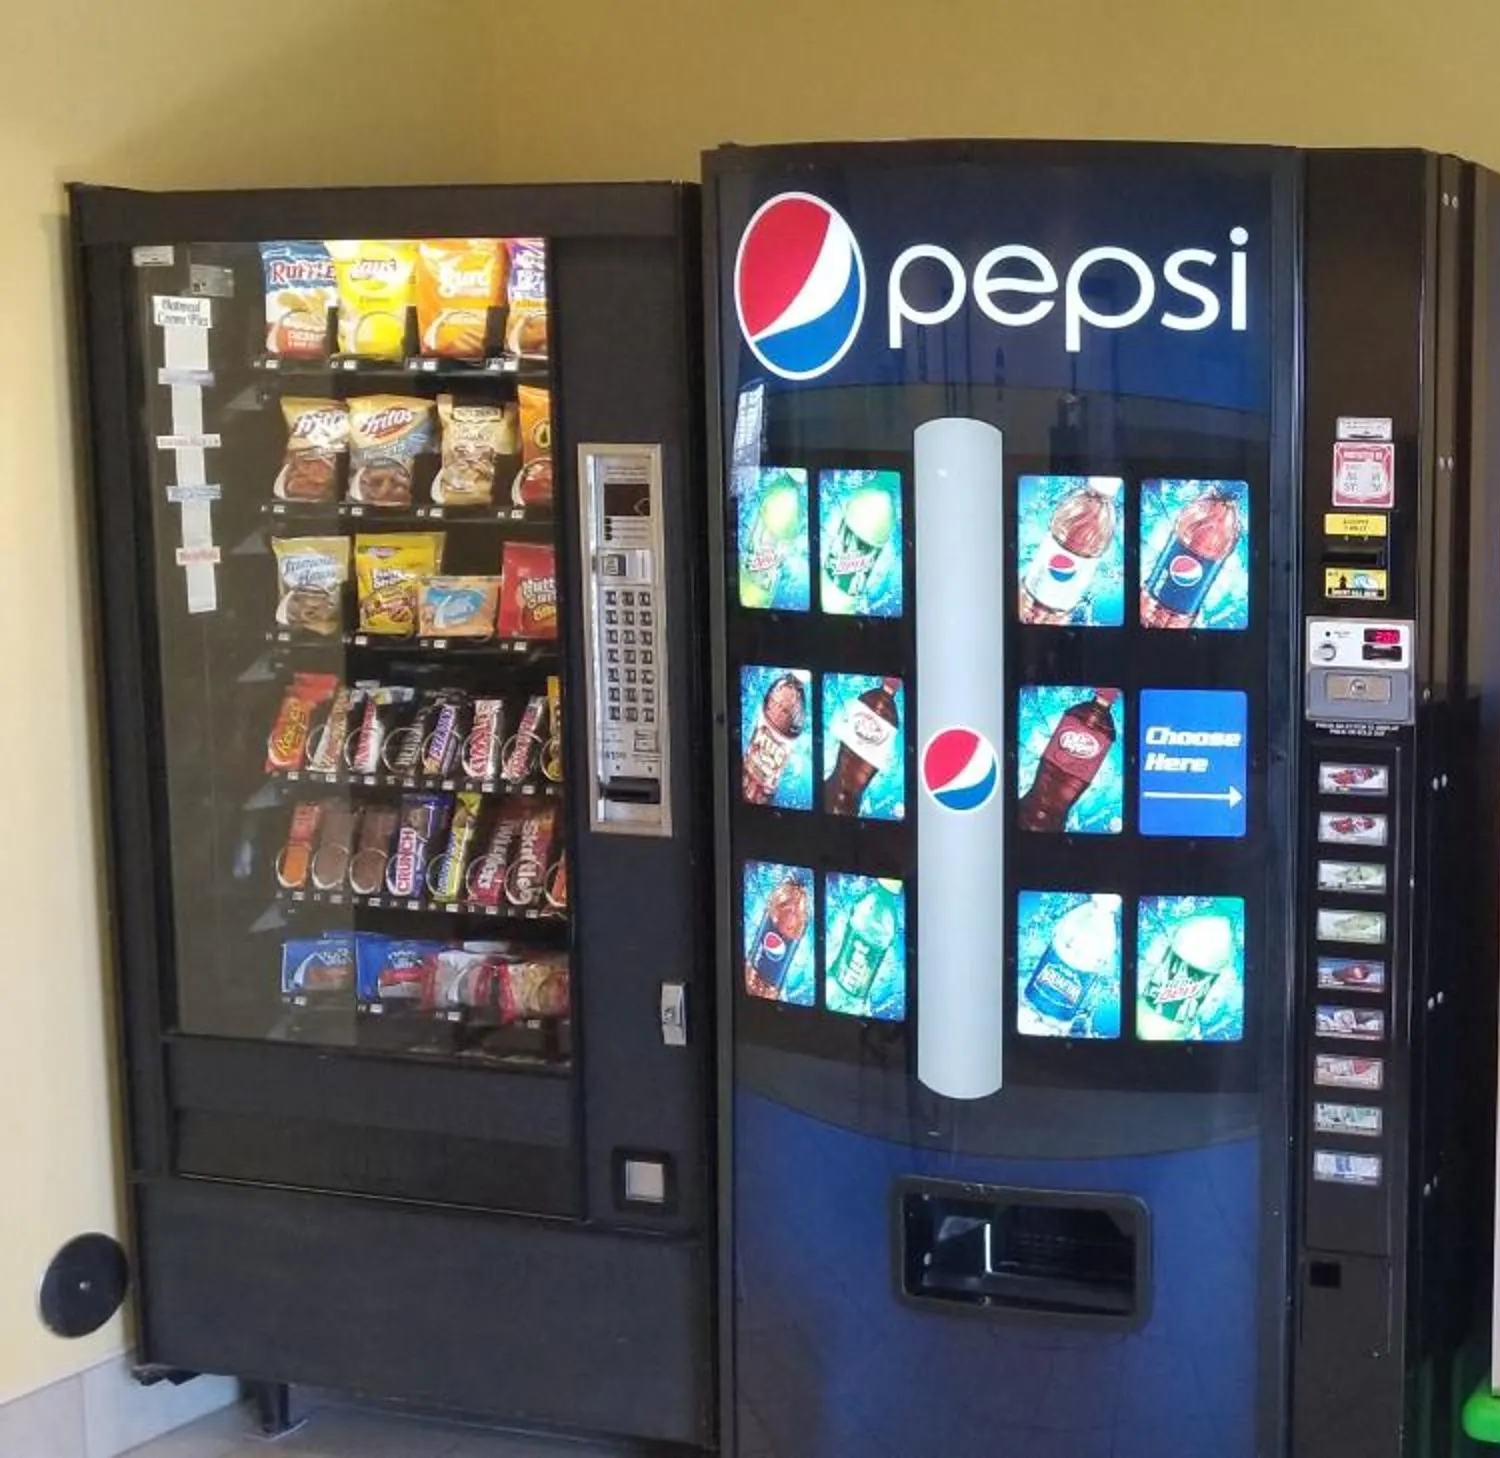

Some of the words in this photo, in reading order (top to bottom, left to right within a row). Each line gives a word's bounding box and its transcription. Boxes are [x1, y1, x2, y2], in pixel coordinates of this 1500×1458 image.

[271, 259, 337, 285] RUFFLE
[889, 226, 1249, 352] pepsi
[1145, 726, 1242, 747] Choose
[1144, 752, 1209, 773] Here
[397, 827, 416, 892] CRUNCH
